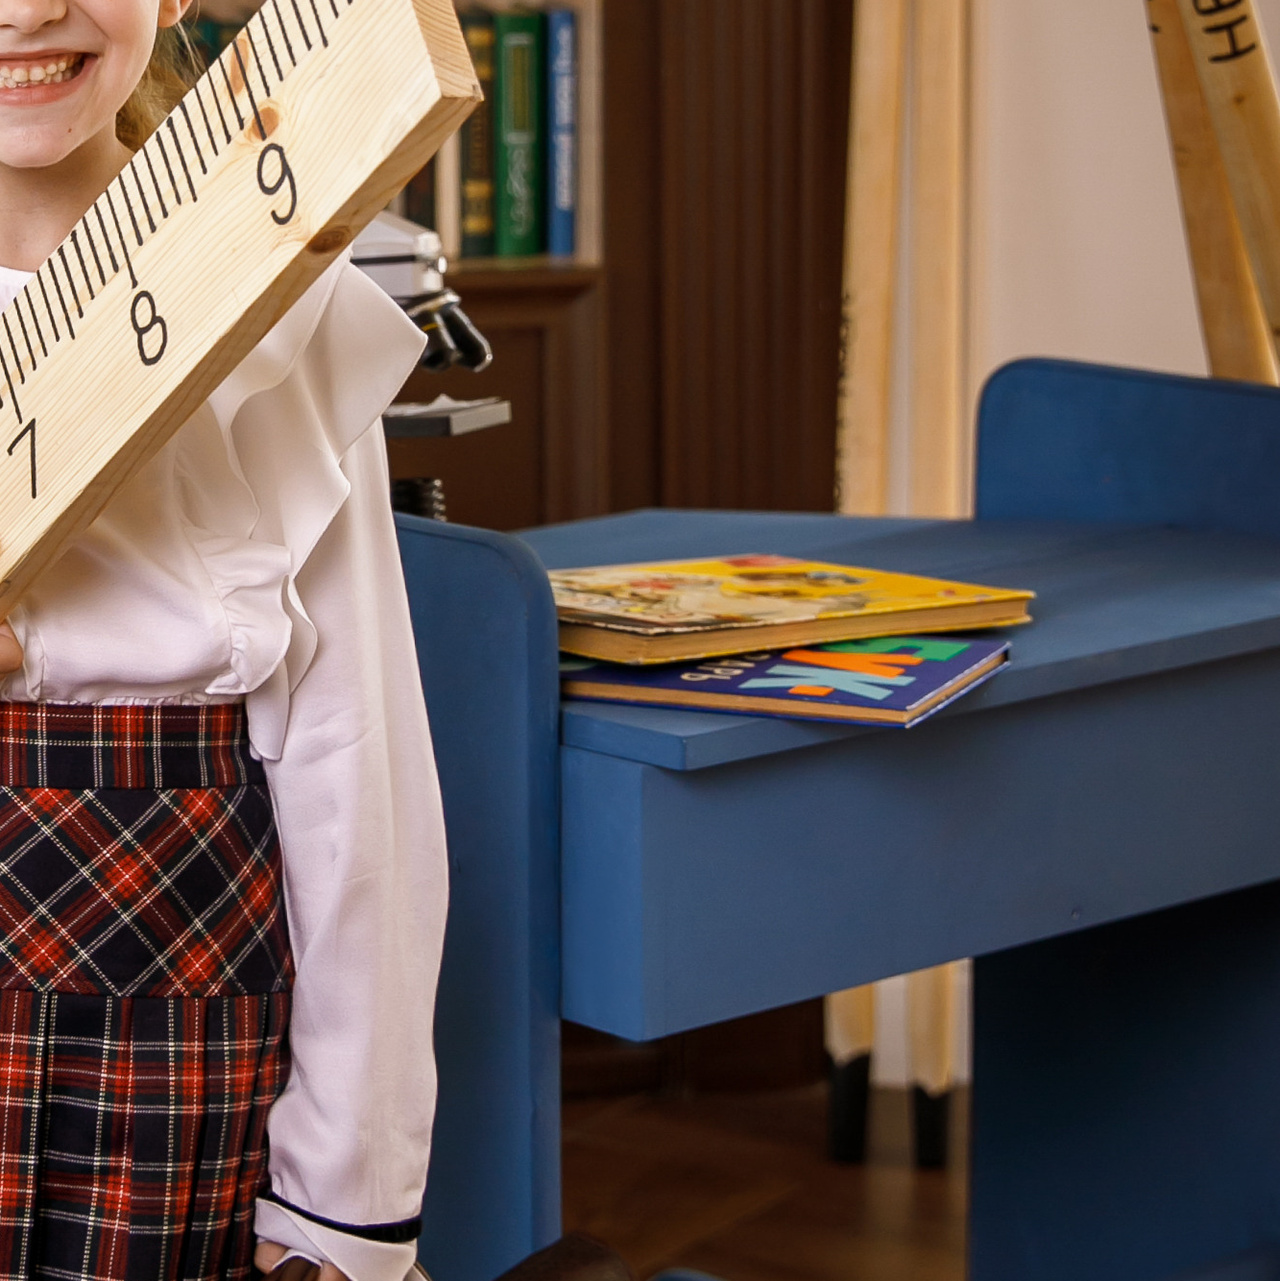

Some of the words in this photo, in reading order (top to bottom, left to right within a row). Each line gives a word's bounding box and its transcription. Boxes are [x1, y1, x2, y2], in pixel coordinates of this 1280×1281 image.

[7, 418, 37, 499] 7
[130, 290, 167, 366] 8
[257, 143, 297, 225] 9
